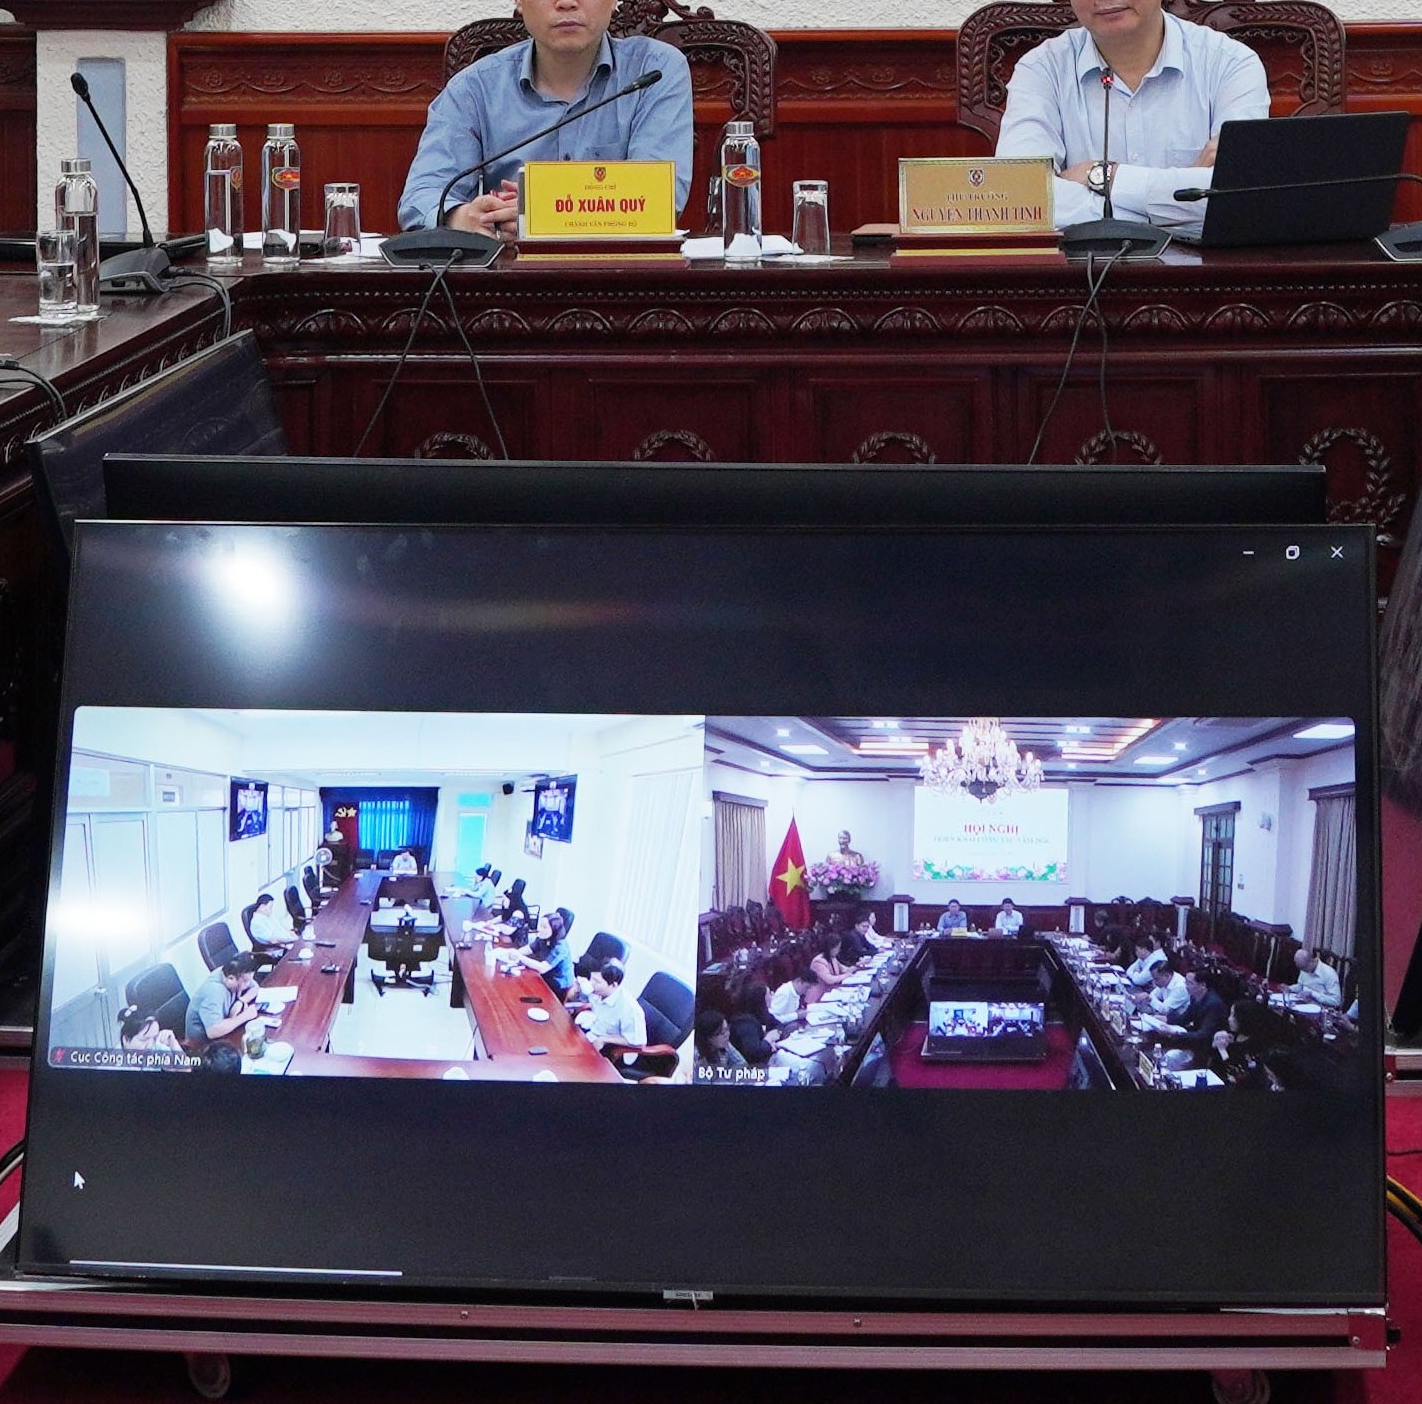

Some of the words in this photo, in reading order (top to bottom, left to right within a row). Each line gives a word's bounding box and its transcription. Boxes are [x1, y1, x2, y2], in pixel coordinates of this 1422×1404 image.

[578, 196, 616, 212] XUÂN
[619, 195, 646, 214] QUÝ
[94, 1050, 124, 1067] Công
[127, 1052, 143, 1065] tác
[146, 1052, 172, 1067] phía
[174, 1053, 202, 1067] Nam
[698, 1065, 714, 1081] Bộ
[716, 1066, 733, 1079] Tư
[735, 1065, 766, 1082] pháp
